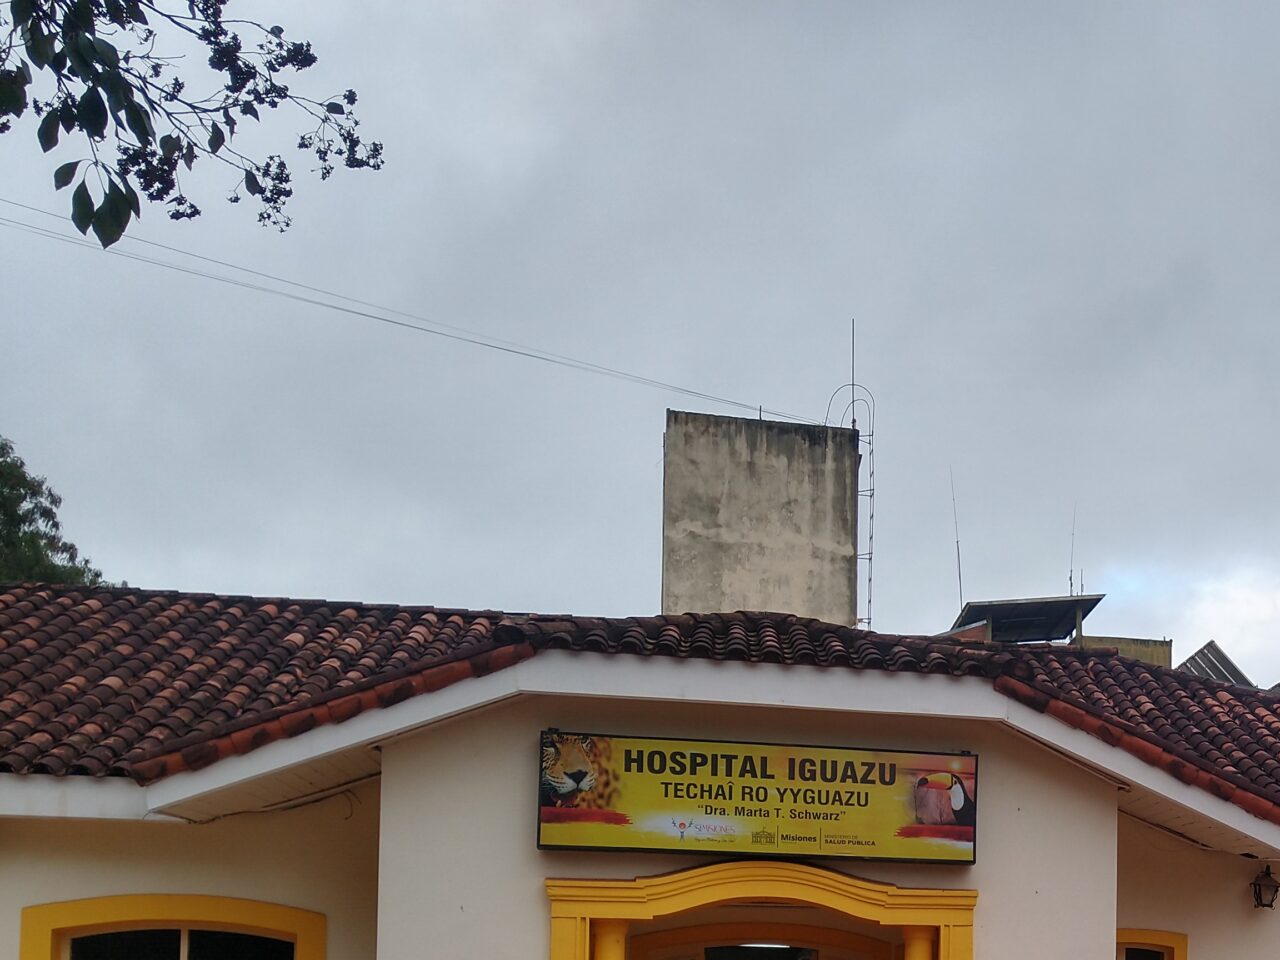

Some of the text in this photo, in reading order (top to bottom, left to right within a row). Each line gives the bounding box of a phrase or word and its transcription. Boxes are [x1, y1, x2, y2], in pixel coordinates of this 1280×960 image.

[624, 749, 897, 786] HOSPITAL IGUAZU
[741, 786, 768, 803] RO
[776, 788, 869, 807] YYGUAZU
[735, 806, 770, 818] Marta
[774, 808, 785, 819] T.
[781, 834, 817, 842] Misiones
